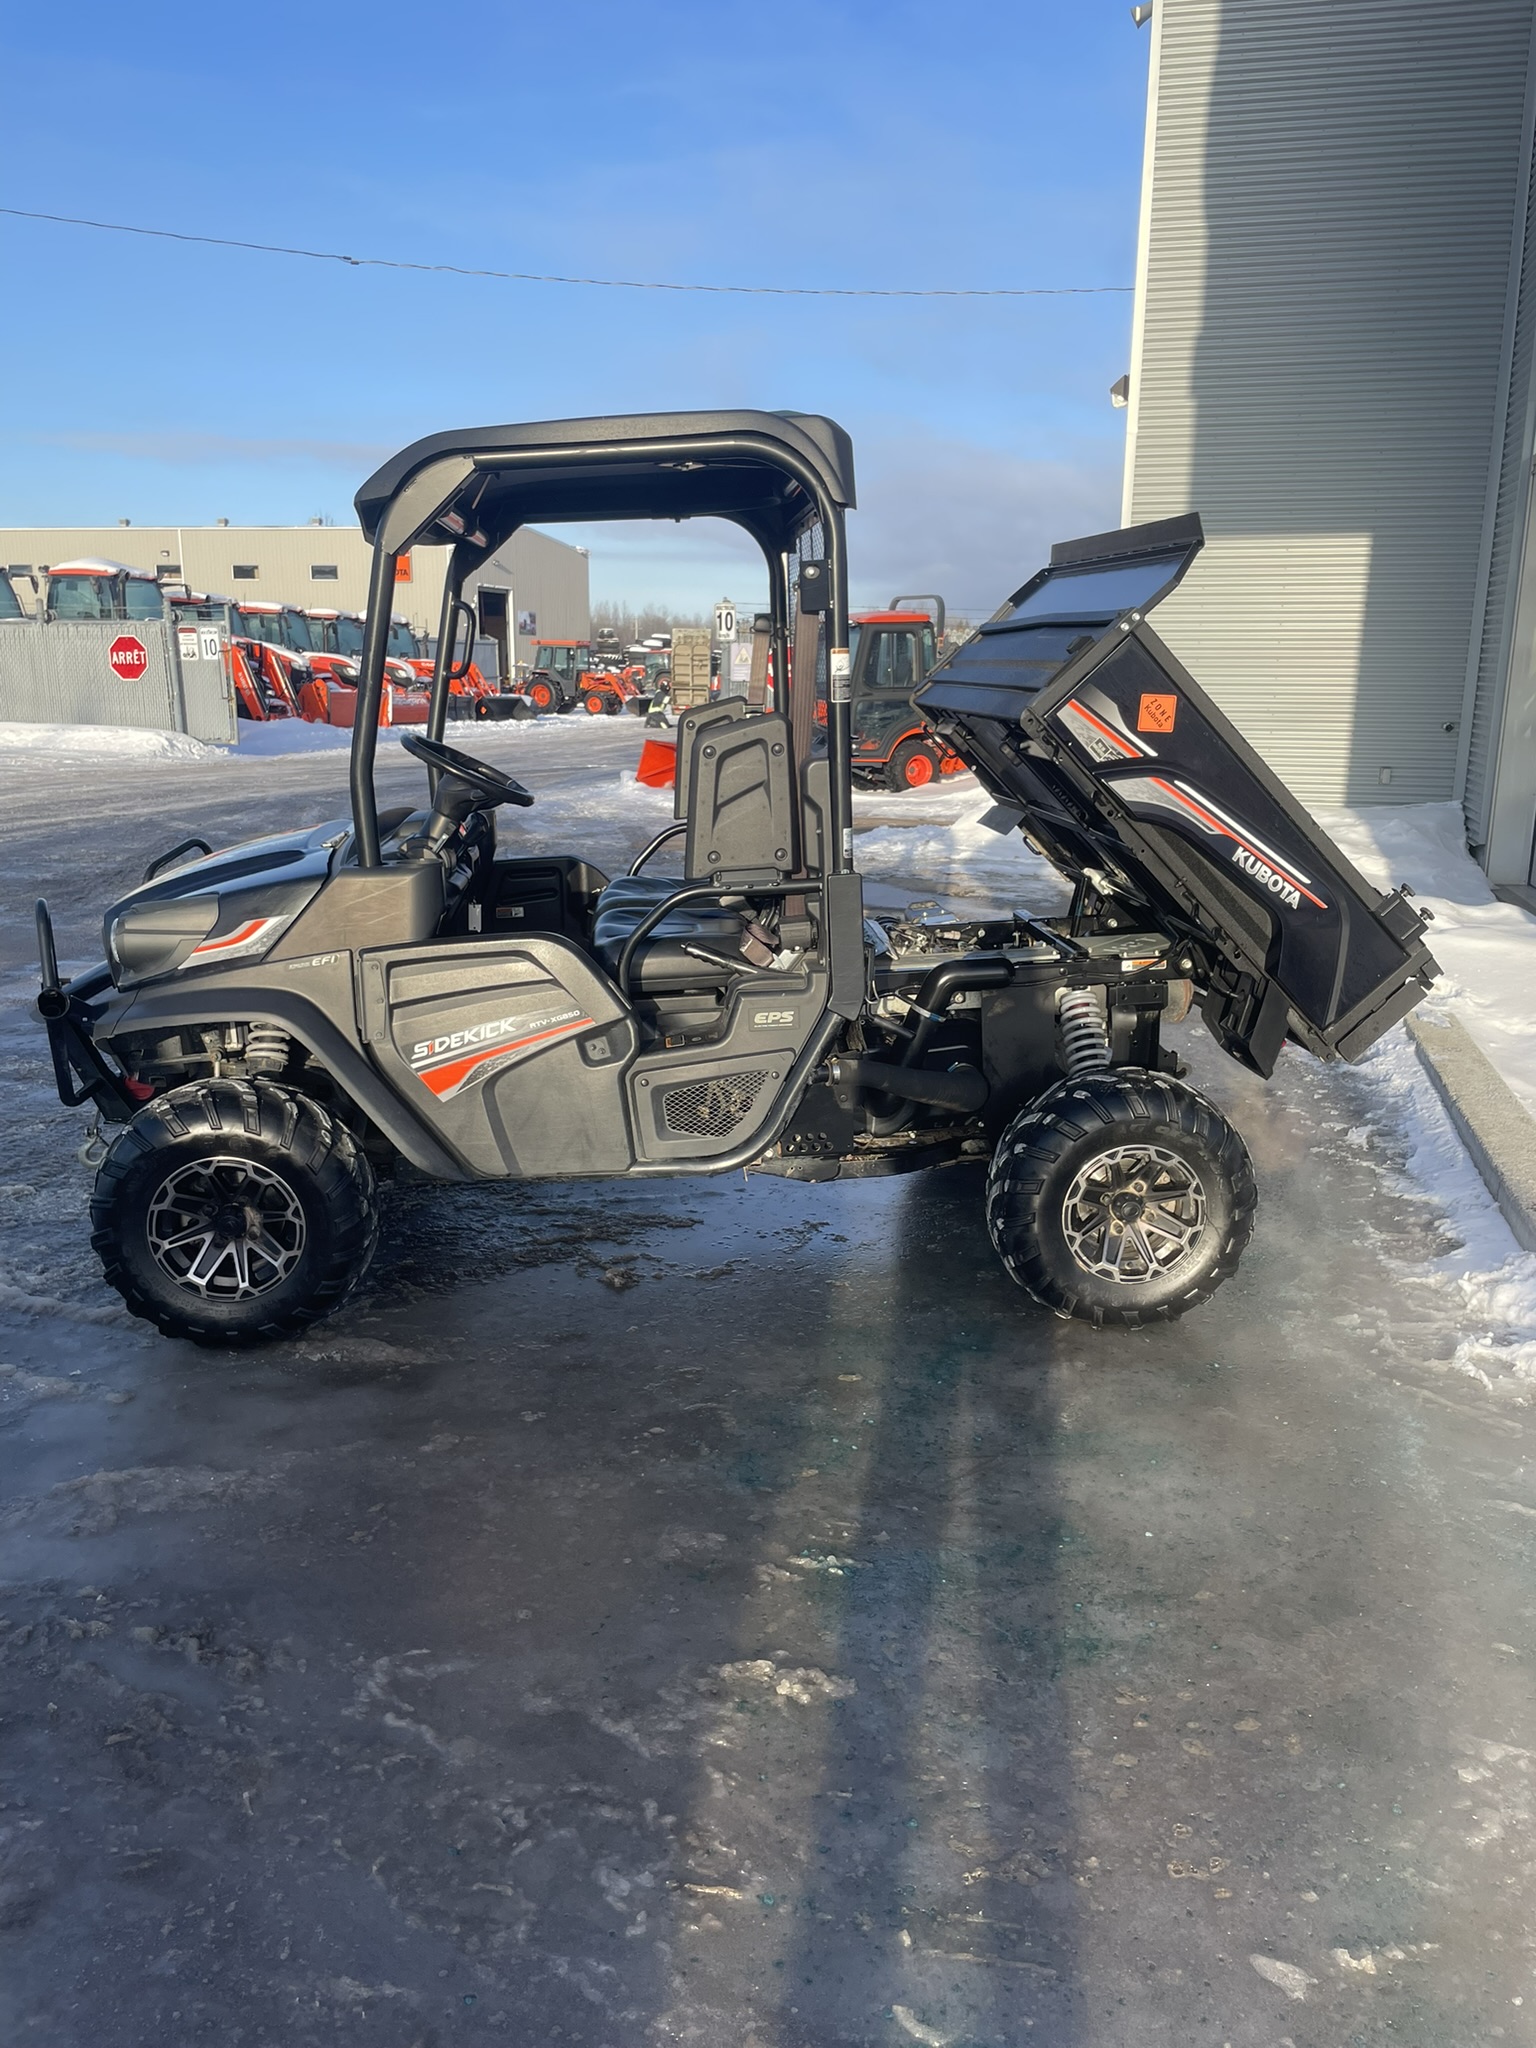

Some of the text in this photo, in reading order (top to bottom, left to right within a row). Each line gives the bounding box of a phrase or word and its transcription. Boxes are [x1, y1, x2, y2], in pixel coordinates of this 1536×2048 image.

[716, 611, 734, 632] 10
[203, 638, 218, 656] 10
[112, 649, 146, 665] ARRÊT
[1144, 703, 1164, 728] Kubota
[1150, 698, 1172, 723] ZONE
[1231, 845, 1301, 910] KUBOTA
[311, 955, 335, 967] EFI
[529, 1010, 581, 1029] RTV-XG850
[754, 1010, 795, 1024] EPS
